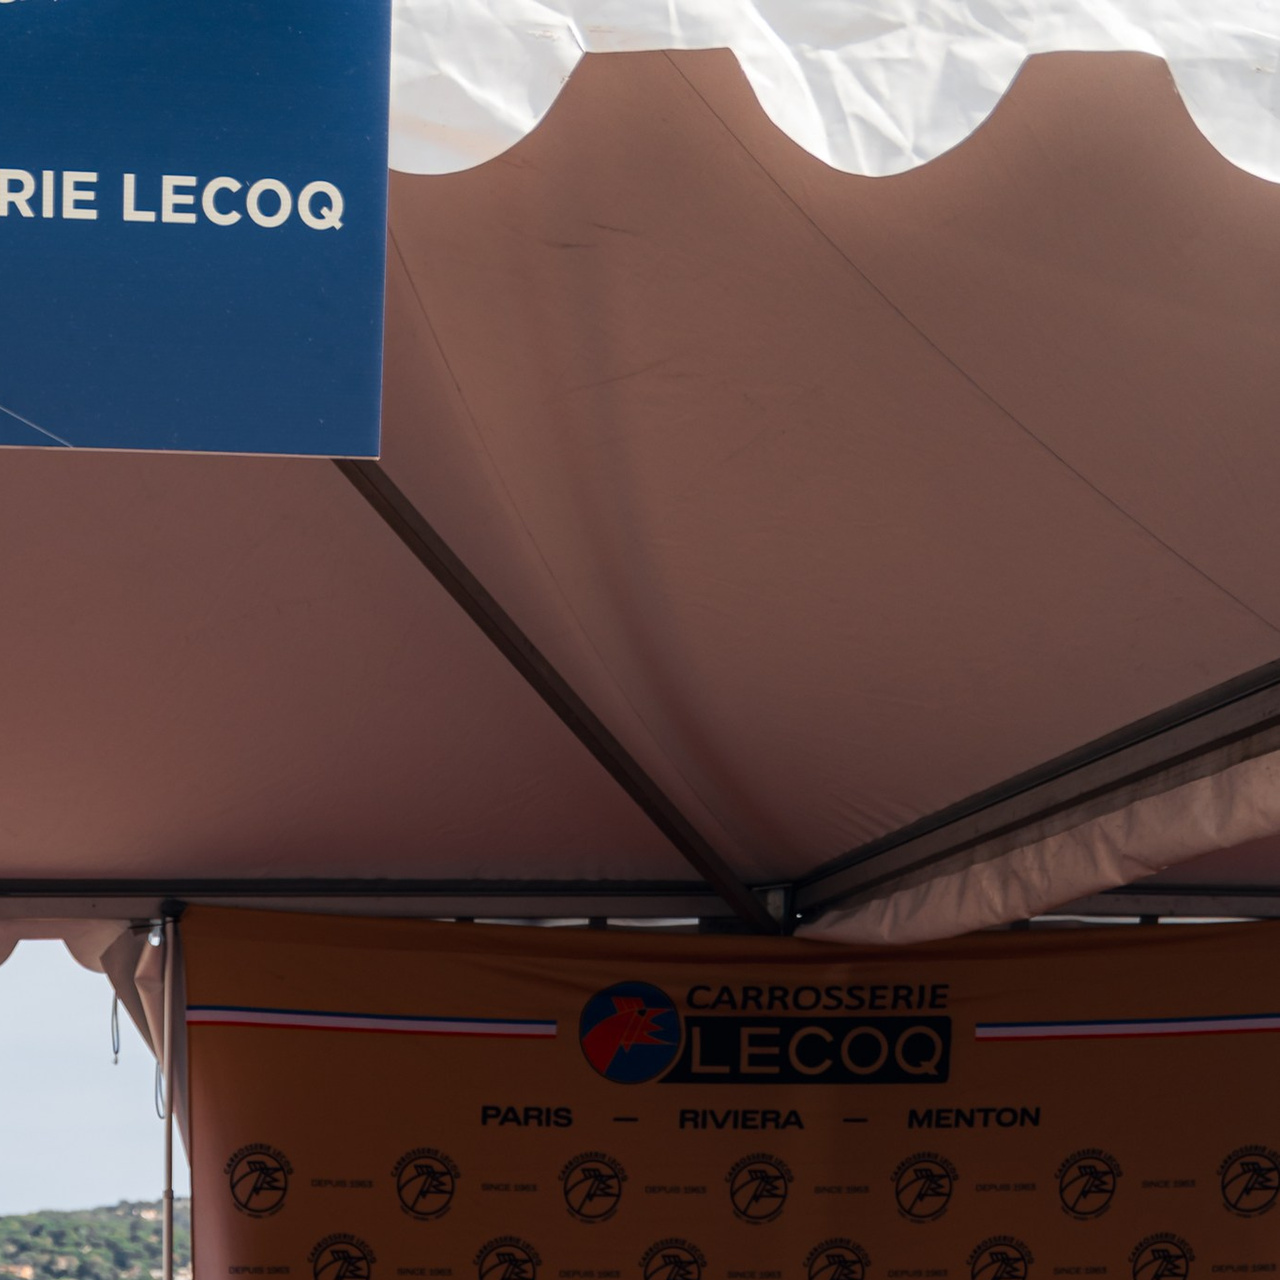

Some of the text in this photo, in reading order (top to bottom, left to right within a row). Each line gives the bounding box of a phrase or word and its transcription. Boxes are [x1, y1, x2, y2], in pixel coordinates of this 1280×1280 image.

[122, 173, 345, 230] LECOQ
[687, 985, 950, 1011] CARROSSERIE
[691, 1026, 943, 1075] LECOQ
[481, 1106, 1041, 1130] PARIS RIVIERA MENTON
